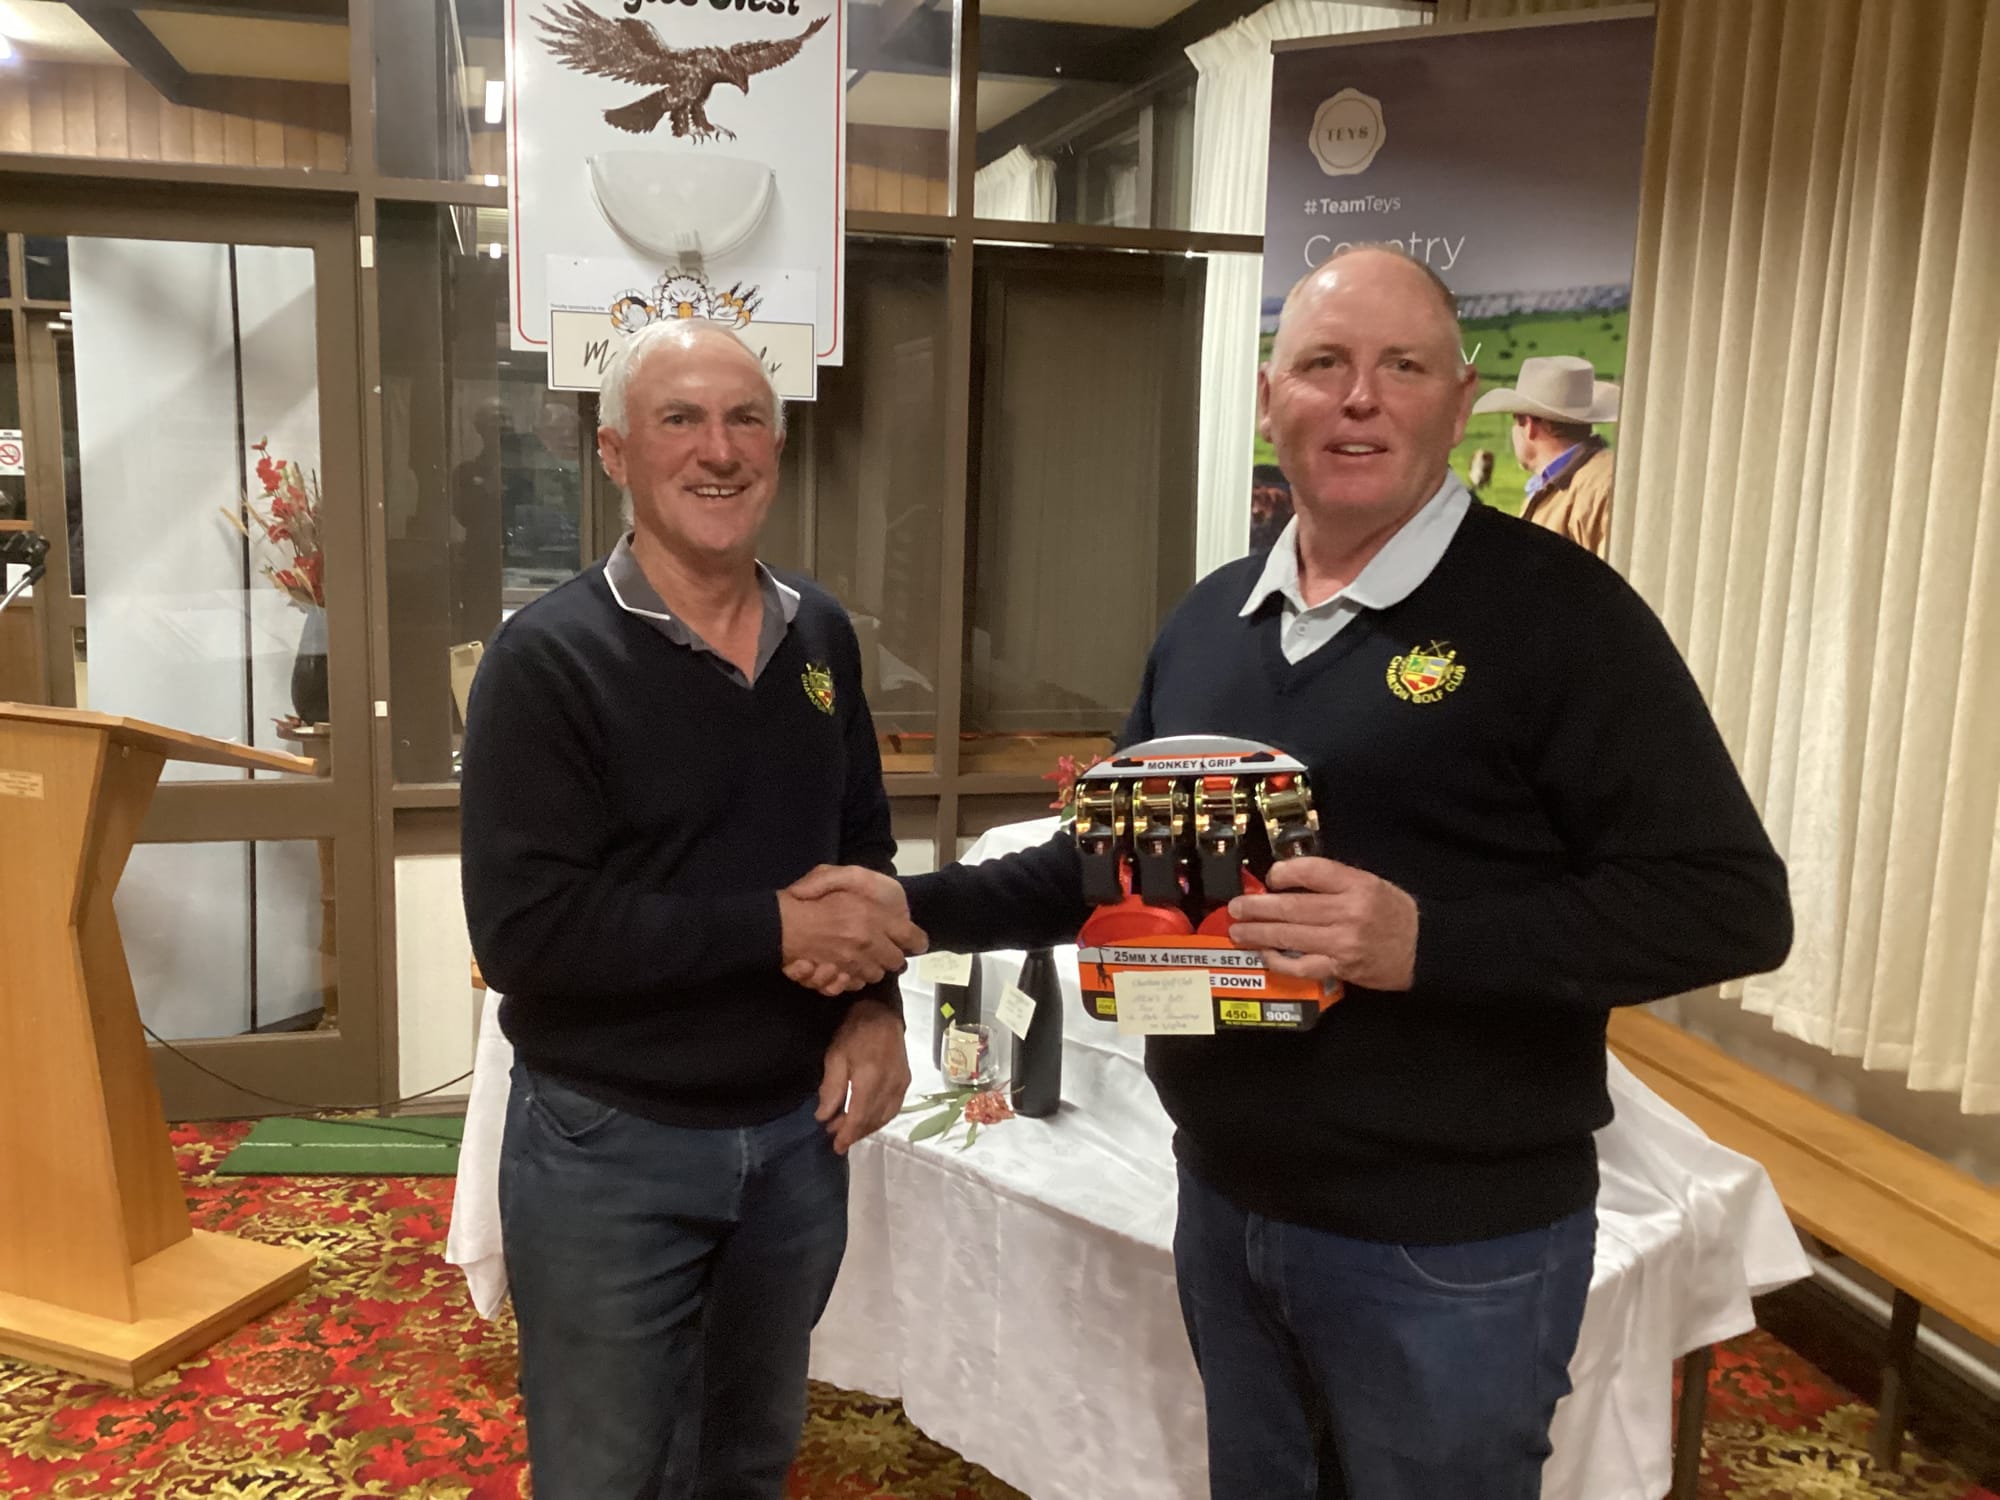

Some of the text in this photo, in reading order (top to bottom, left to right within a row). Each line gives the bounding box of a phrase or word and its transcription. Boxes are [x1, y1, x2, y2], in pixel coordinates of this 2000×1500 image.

[1327, 125, 1369, 142] TEYS
[1304, 195, 1401, 215] #TeamTeys
[1304, 231, 1466, 271] Ctry
[1147, 758, 1237, 770] MONKEY GRIP
[1220, 956, 1241, 966] SET
[1220, 976, 1262, 988] DOWN
